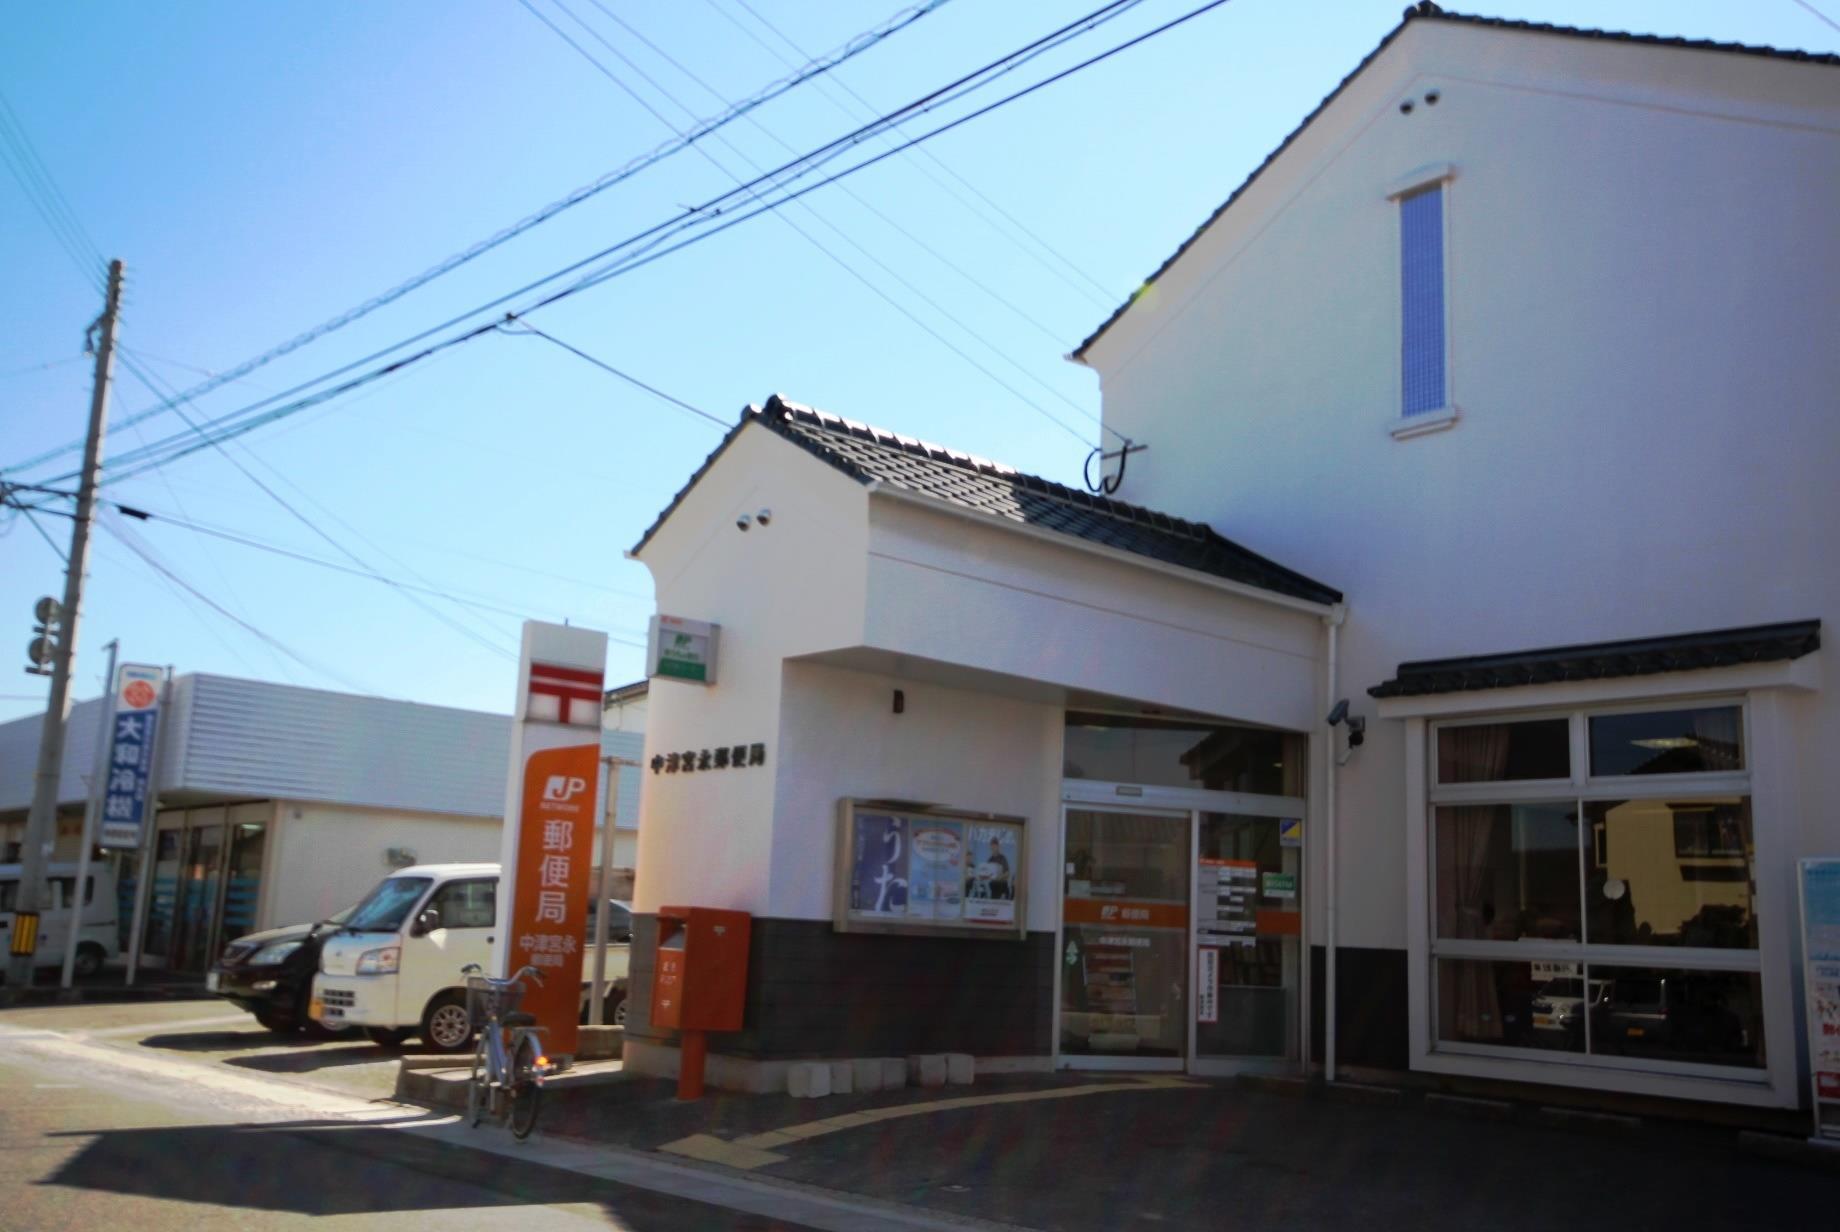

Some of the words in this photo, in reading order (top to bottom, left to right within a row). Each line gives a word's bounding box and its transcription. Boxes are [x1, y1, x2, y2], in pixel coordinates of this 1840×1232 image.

[106, 716, 143, 818] 大和冷機
[535, 819, 574, 924] 郵便局
